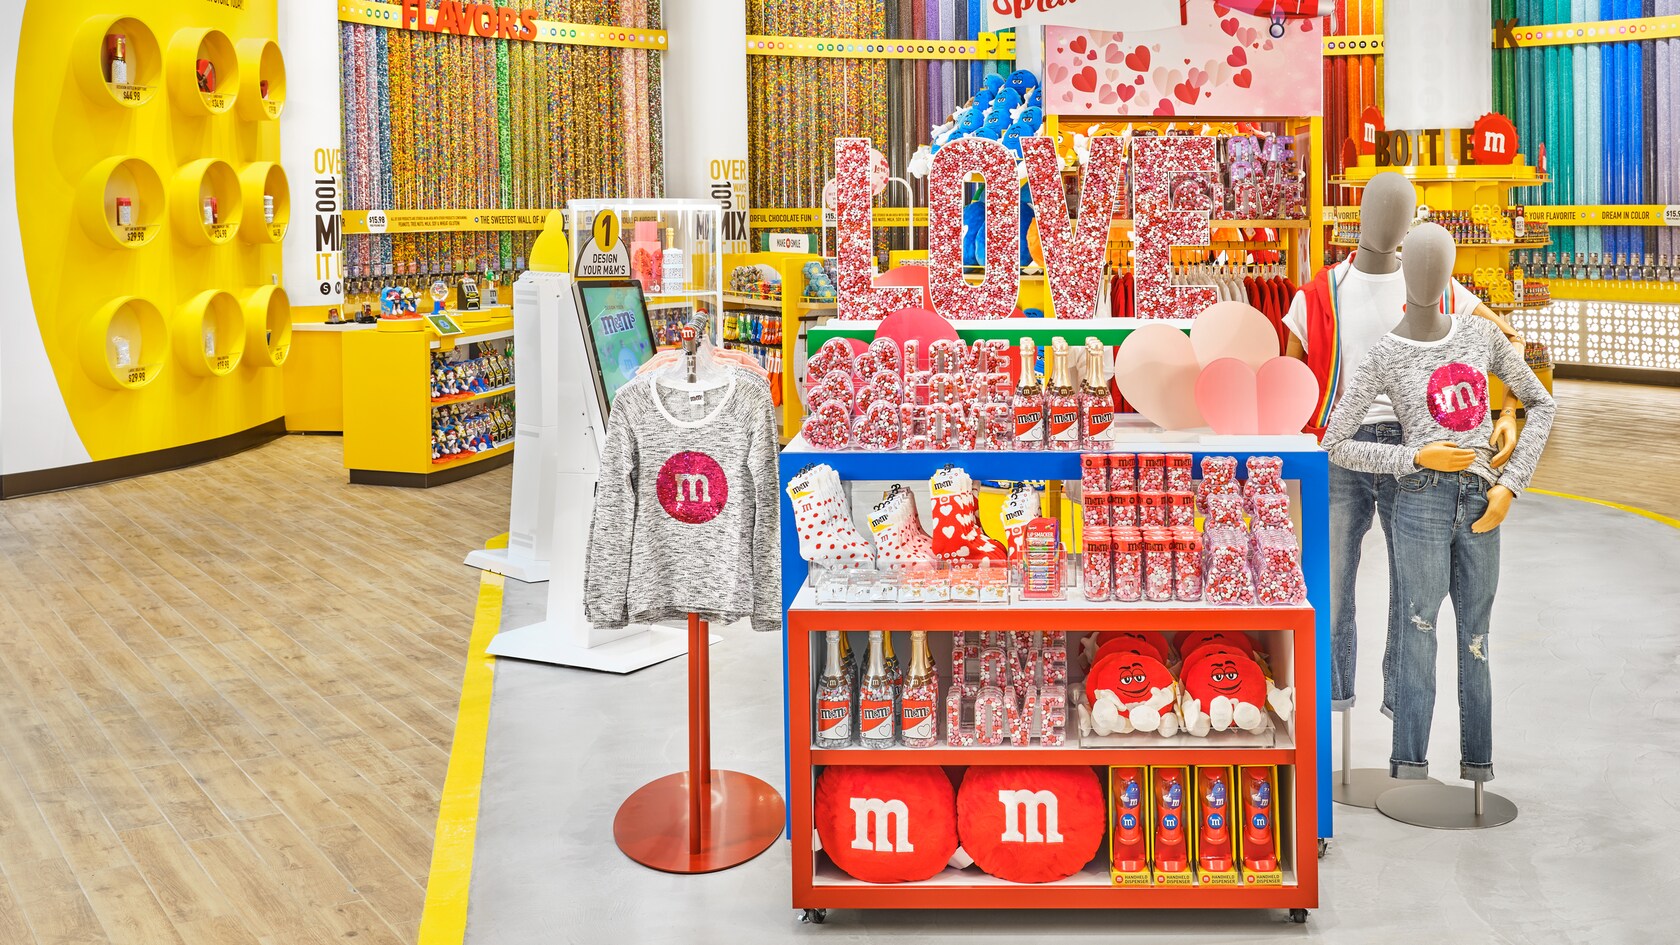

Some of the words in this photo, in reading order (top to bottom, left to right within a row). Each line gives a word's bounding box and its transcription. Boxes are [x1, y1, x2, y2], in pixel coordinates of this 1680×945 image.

[401, 0, 539, 41] FLAVORS
[123, 91, 140, 100] $44.98
[1375, 128, 1475, 167] BOTTLE
[1484, 130, 1506, 154] m
[314, 148, 341, 174] OVE
[710, 160, 746, 180] OVER
[315, 176, 336, 212] 100
[733, 183, 746, 192] WAYS
[736, 194, 746, 210] TO
[480, 216, 490, 224] THE
[491, 216, 516, 224] SWEETEST
[518, 216, 531, 224] WALL
[1530, 212, 1544, 220] YOUR
[1546, 212, 1576, 220] FLAVORITE
[1601, 211, 1622, 220] DREAM
[1623, 211, 1629, 220] IN
[1630, 211, 1650, 220] COLOR
[128, 232, 144, 241] $29.98
[602, 214, 611, 246] 1
[834, 136, 1219, 322] LOVE
[776, 239, 786, 248] MAKE
[791, 239, 801, 248] SMILE
[316, 253, 332, 280] IT
[592, 254, 618, 263] DESIGN
[583, 266, 601, 275] YOUR
[603, 265, 625, 275] M&M'S
[128, 372, 145, 382] $29.98
[1435, 381, 1478, 413] m
[900, 402, 1009, 451] LOVE
[674, 474, 711, 502] m
[802, 502, 813, 513] m
[946, 690, 1066, 747] LOVE
[850, 797, 914, 853] m
[998, 789, 1063, 843] m
[1124, 818, 1133, 826] m
[1166, 819, 1175, 827] m
